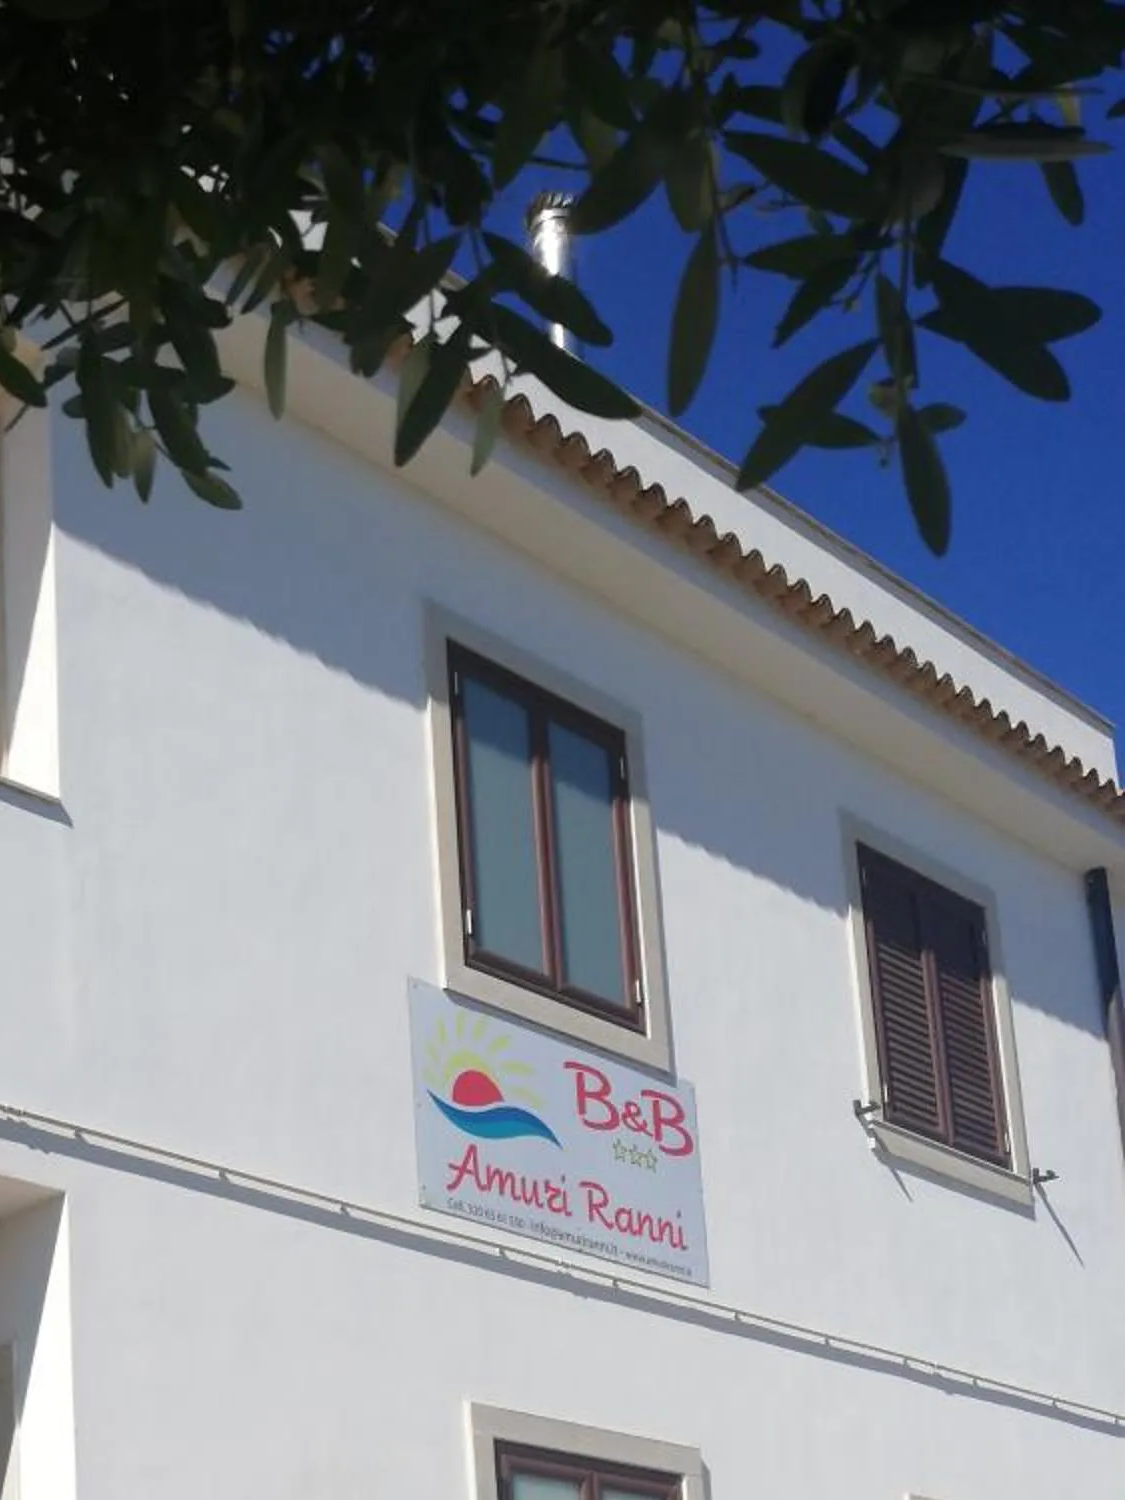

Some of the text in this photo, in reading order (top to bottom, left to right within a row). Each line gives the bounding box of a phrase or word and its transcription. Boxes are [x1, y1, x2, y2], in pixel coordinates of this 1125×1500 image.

[563, 1060, 695, 1158] B&B
[445, 1143, 689, 1251] Amuri Ranni
